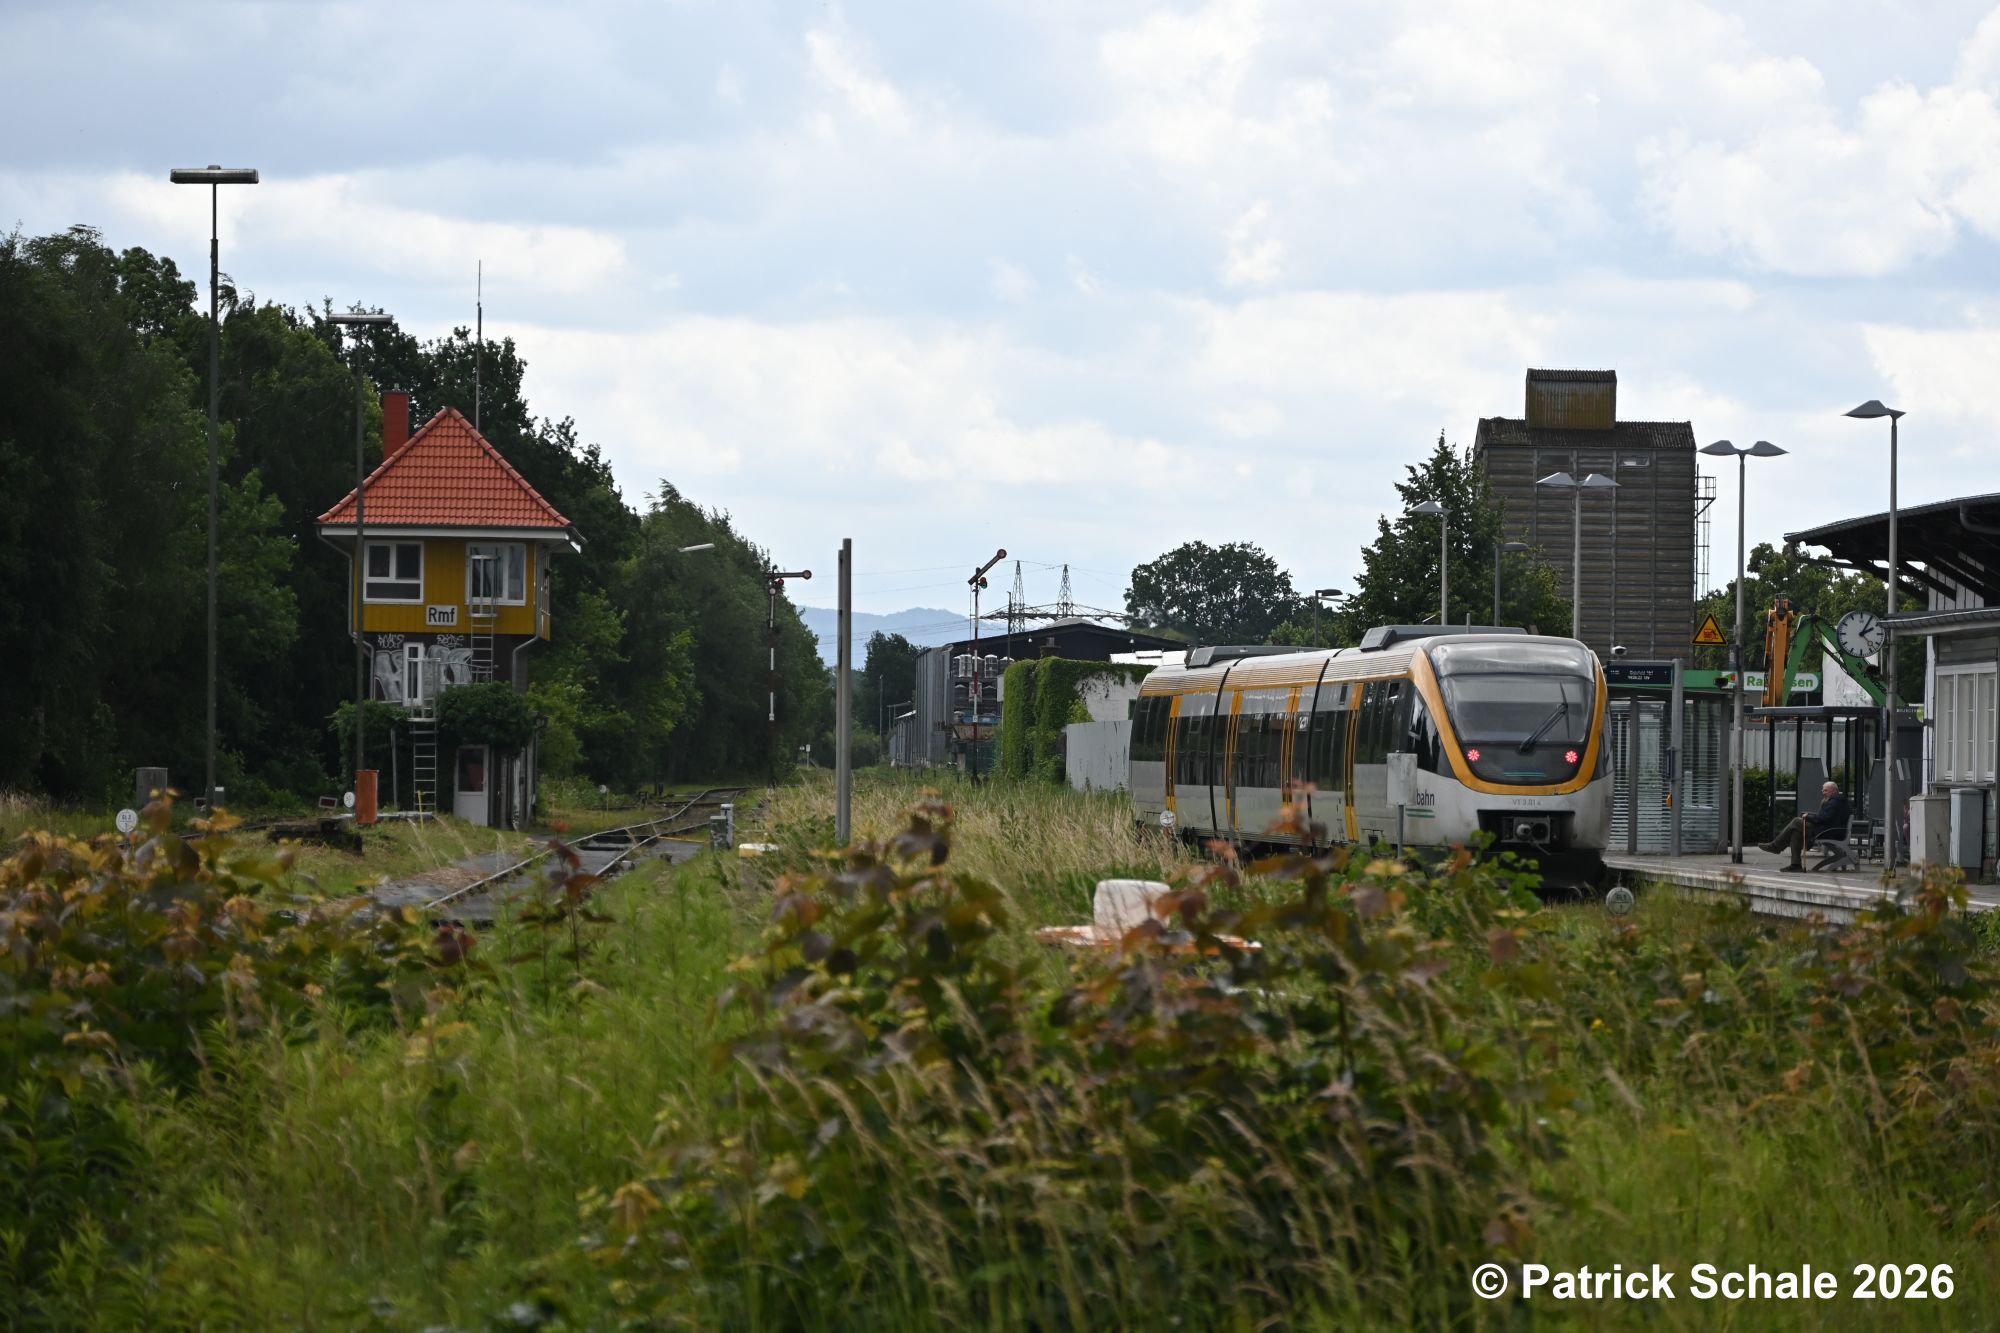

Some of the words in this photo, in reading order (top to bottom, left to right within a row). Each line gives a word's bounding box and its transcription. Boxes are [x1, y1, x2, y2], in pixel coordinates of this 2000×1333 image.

[429, 607, 455, 623] Rmf
[1746, 675, 1814, 688] Rasen
[1416, 787, 1434, 806] bahn
